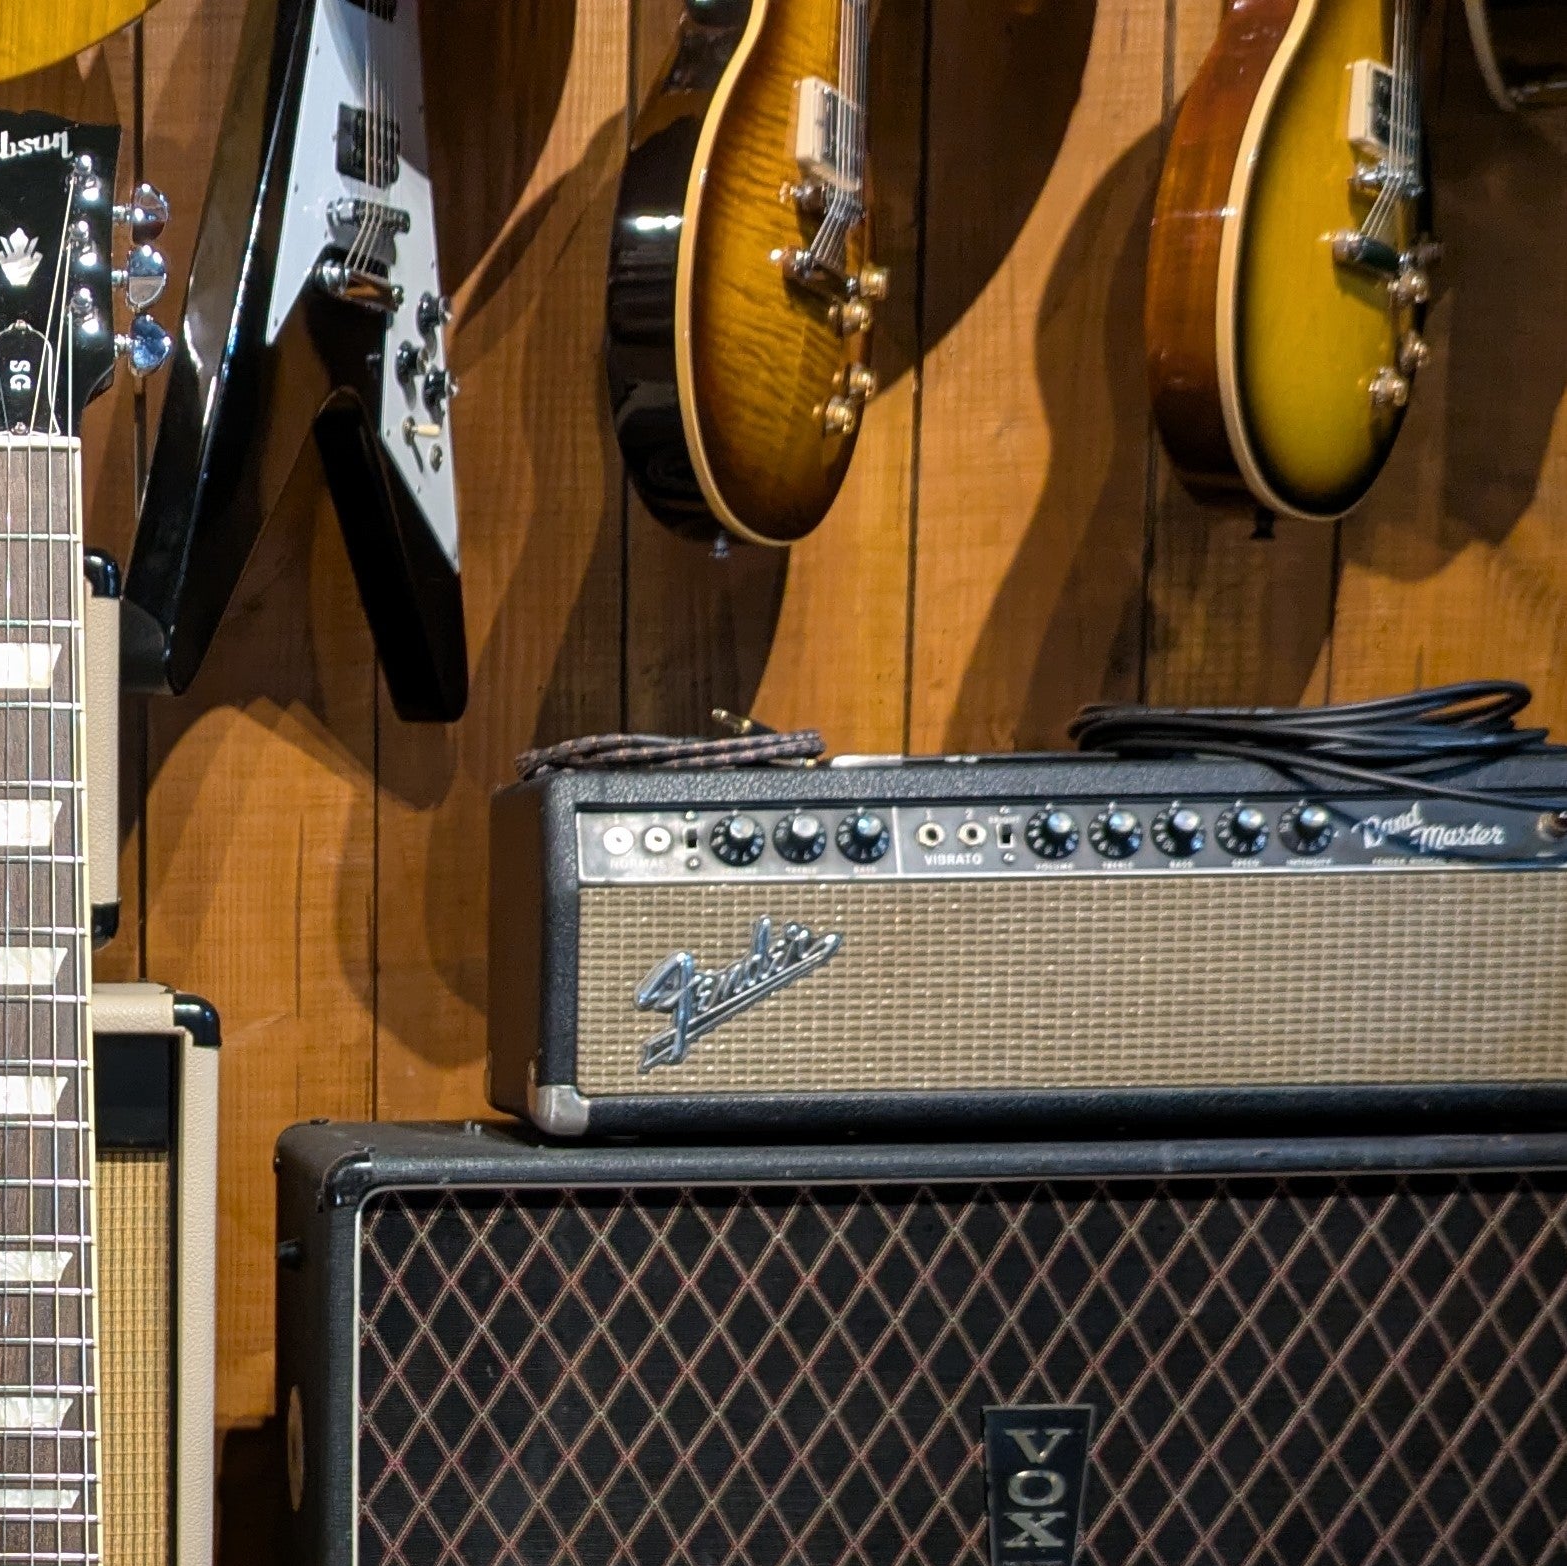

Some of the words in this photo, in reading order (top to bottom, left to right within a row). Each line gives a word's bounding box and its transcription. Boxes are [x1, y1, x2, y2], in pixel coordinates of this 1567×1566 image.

[9, 359, 31, 391] SG
[1351, 801, 1423, 849] Band
[1410, 821, 1505, 852] Master
[924, 853, 983, 866] VIBRATO
[636, 914, 840, 1068] Fender
[1002, 1428, 1072, 1548] VOX
